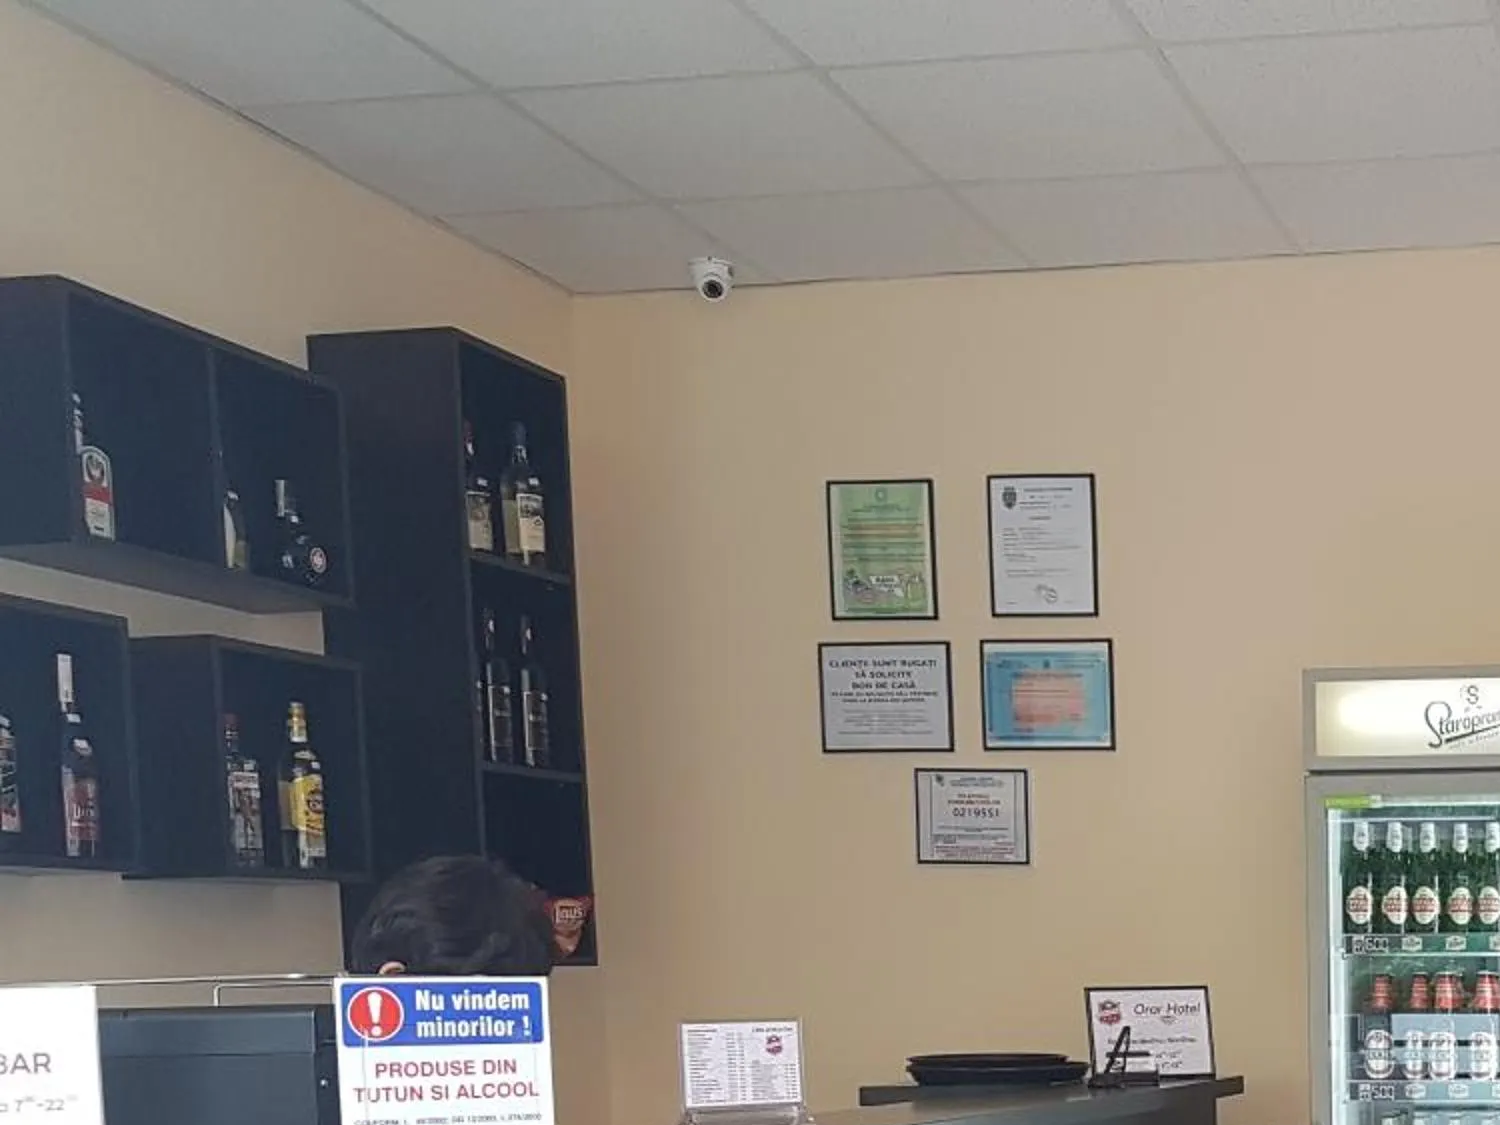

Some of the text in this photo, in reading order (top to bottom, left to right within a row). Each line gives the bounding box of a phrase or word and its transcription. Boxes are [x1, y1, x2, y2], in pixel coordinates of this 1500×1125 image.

[415, 989, 530, 1011] Nu vindem
[416, 1016, 515, 1038] minorilor
[375, 1058, 517, 1078] PRODUSE DIN
[353, 1085, 424, 1103] TUTUN
[455, 1081, 540, 1100] ALCOOL
